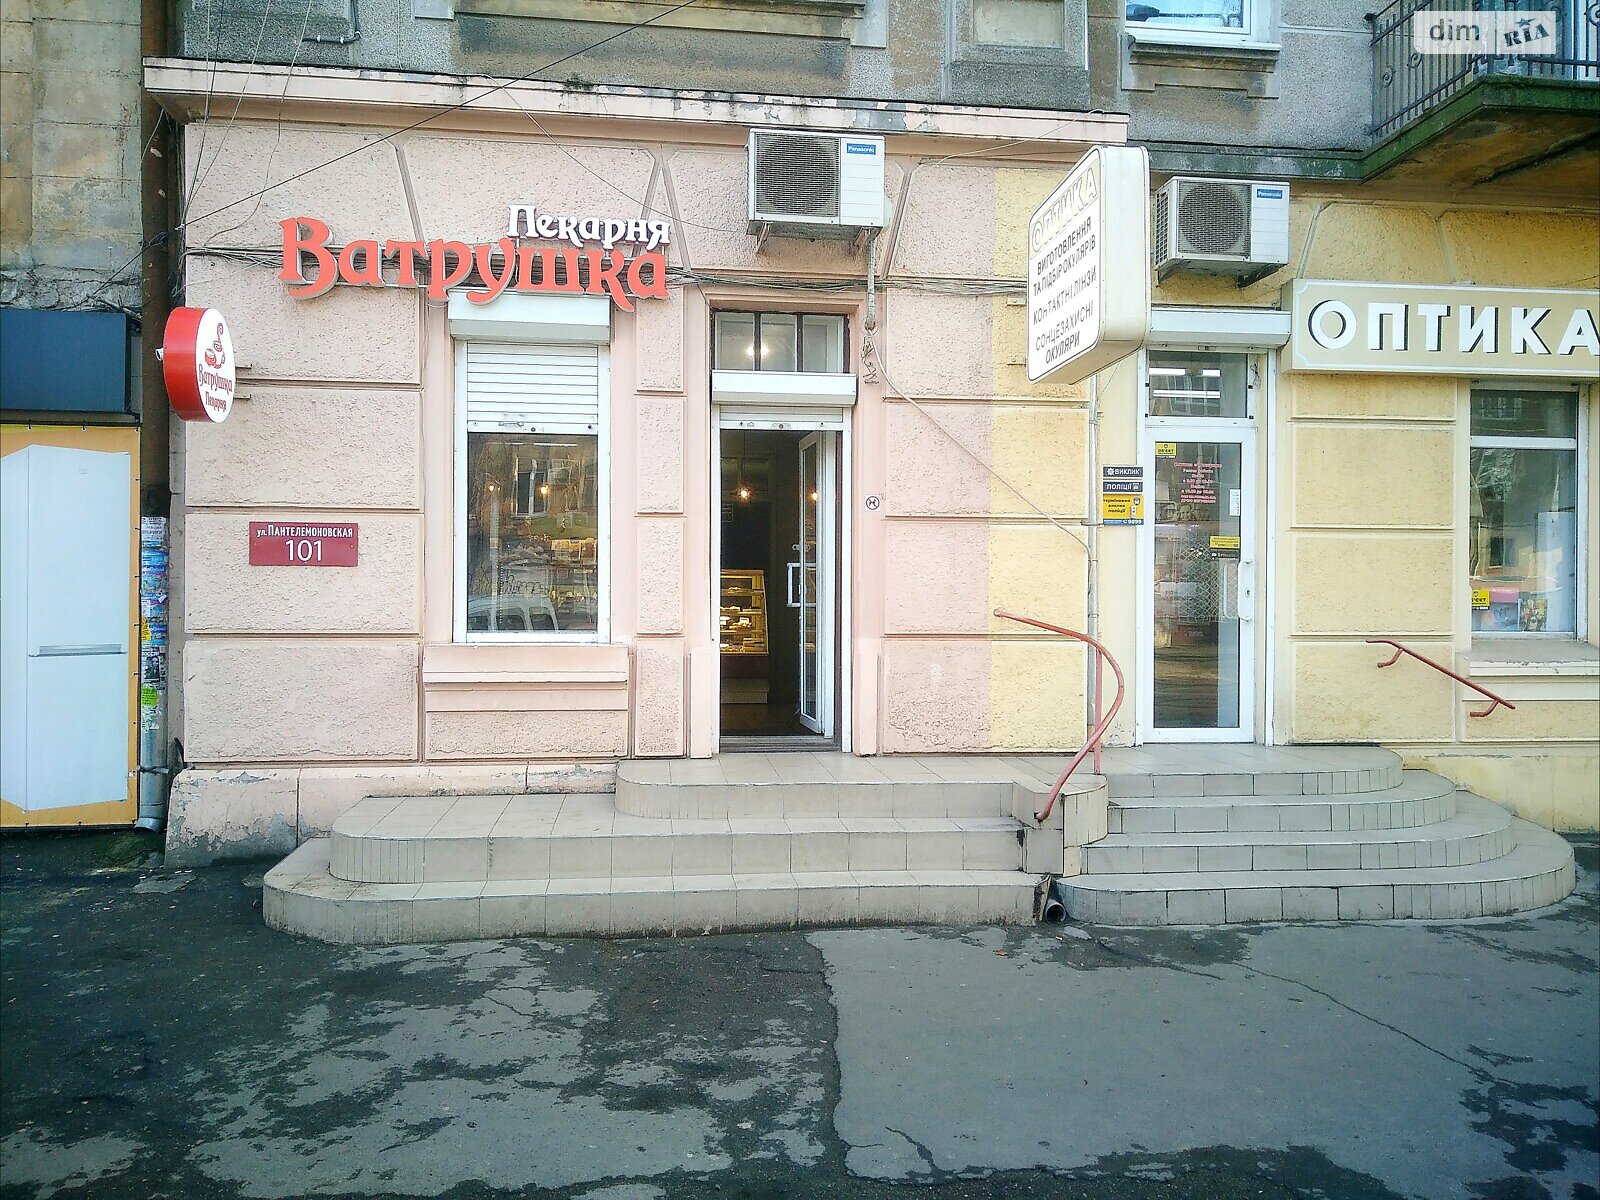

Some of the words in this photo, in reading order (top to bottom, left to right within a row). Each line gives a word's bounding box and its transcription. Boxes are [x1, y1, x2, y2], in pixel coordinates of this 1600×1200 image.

[848, 145, 874, 153] Panasonic
[506, 204, 671, 251] Пекарня
[1031, 167, 1098, 253] ОПТИКА
[278, 216, 671, 312] Ватрушка
[1037, 216, 1092, 276] ВИГОТОВЛЕННЯ
[1063, 234, 1096, 275] ОКУЛЯРІВ
[1033, 285, 1072, 326] КОНТАКТНІ
[1035, 299, 1094, 351] СОНЦЕЗАХИСНІ
[1045, 331, 1080, 364] ОКУЛЯРИ
[1308, 299, 1600, 356] ОПТИКА
[198, 364, 233, 395] Ватрушка
[205, 391, 227, 412] Пекарня
[285, 539, 322, 561] 101
